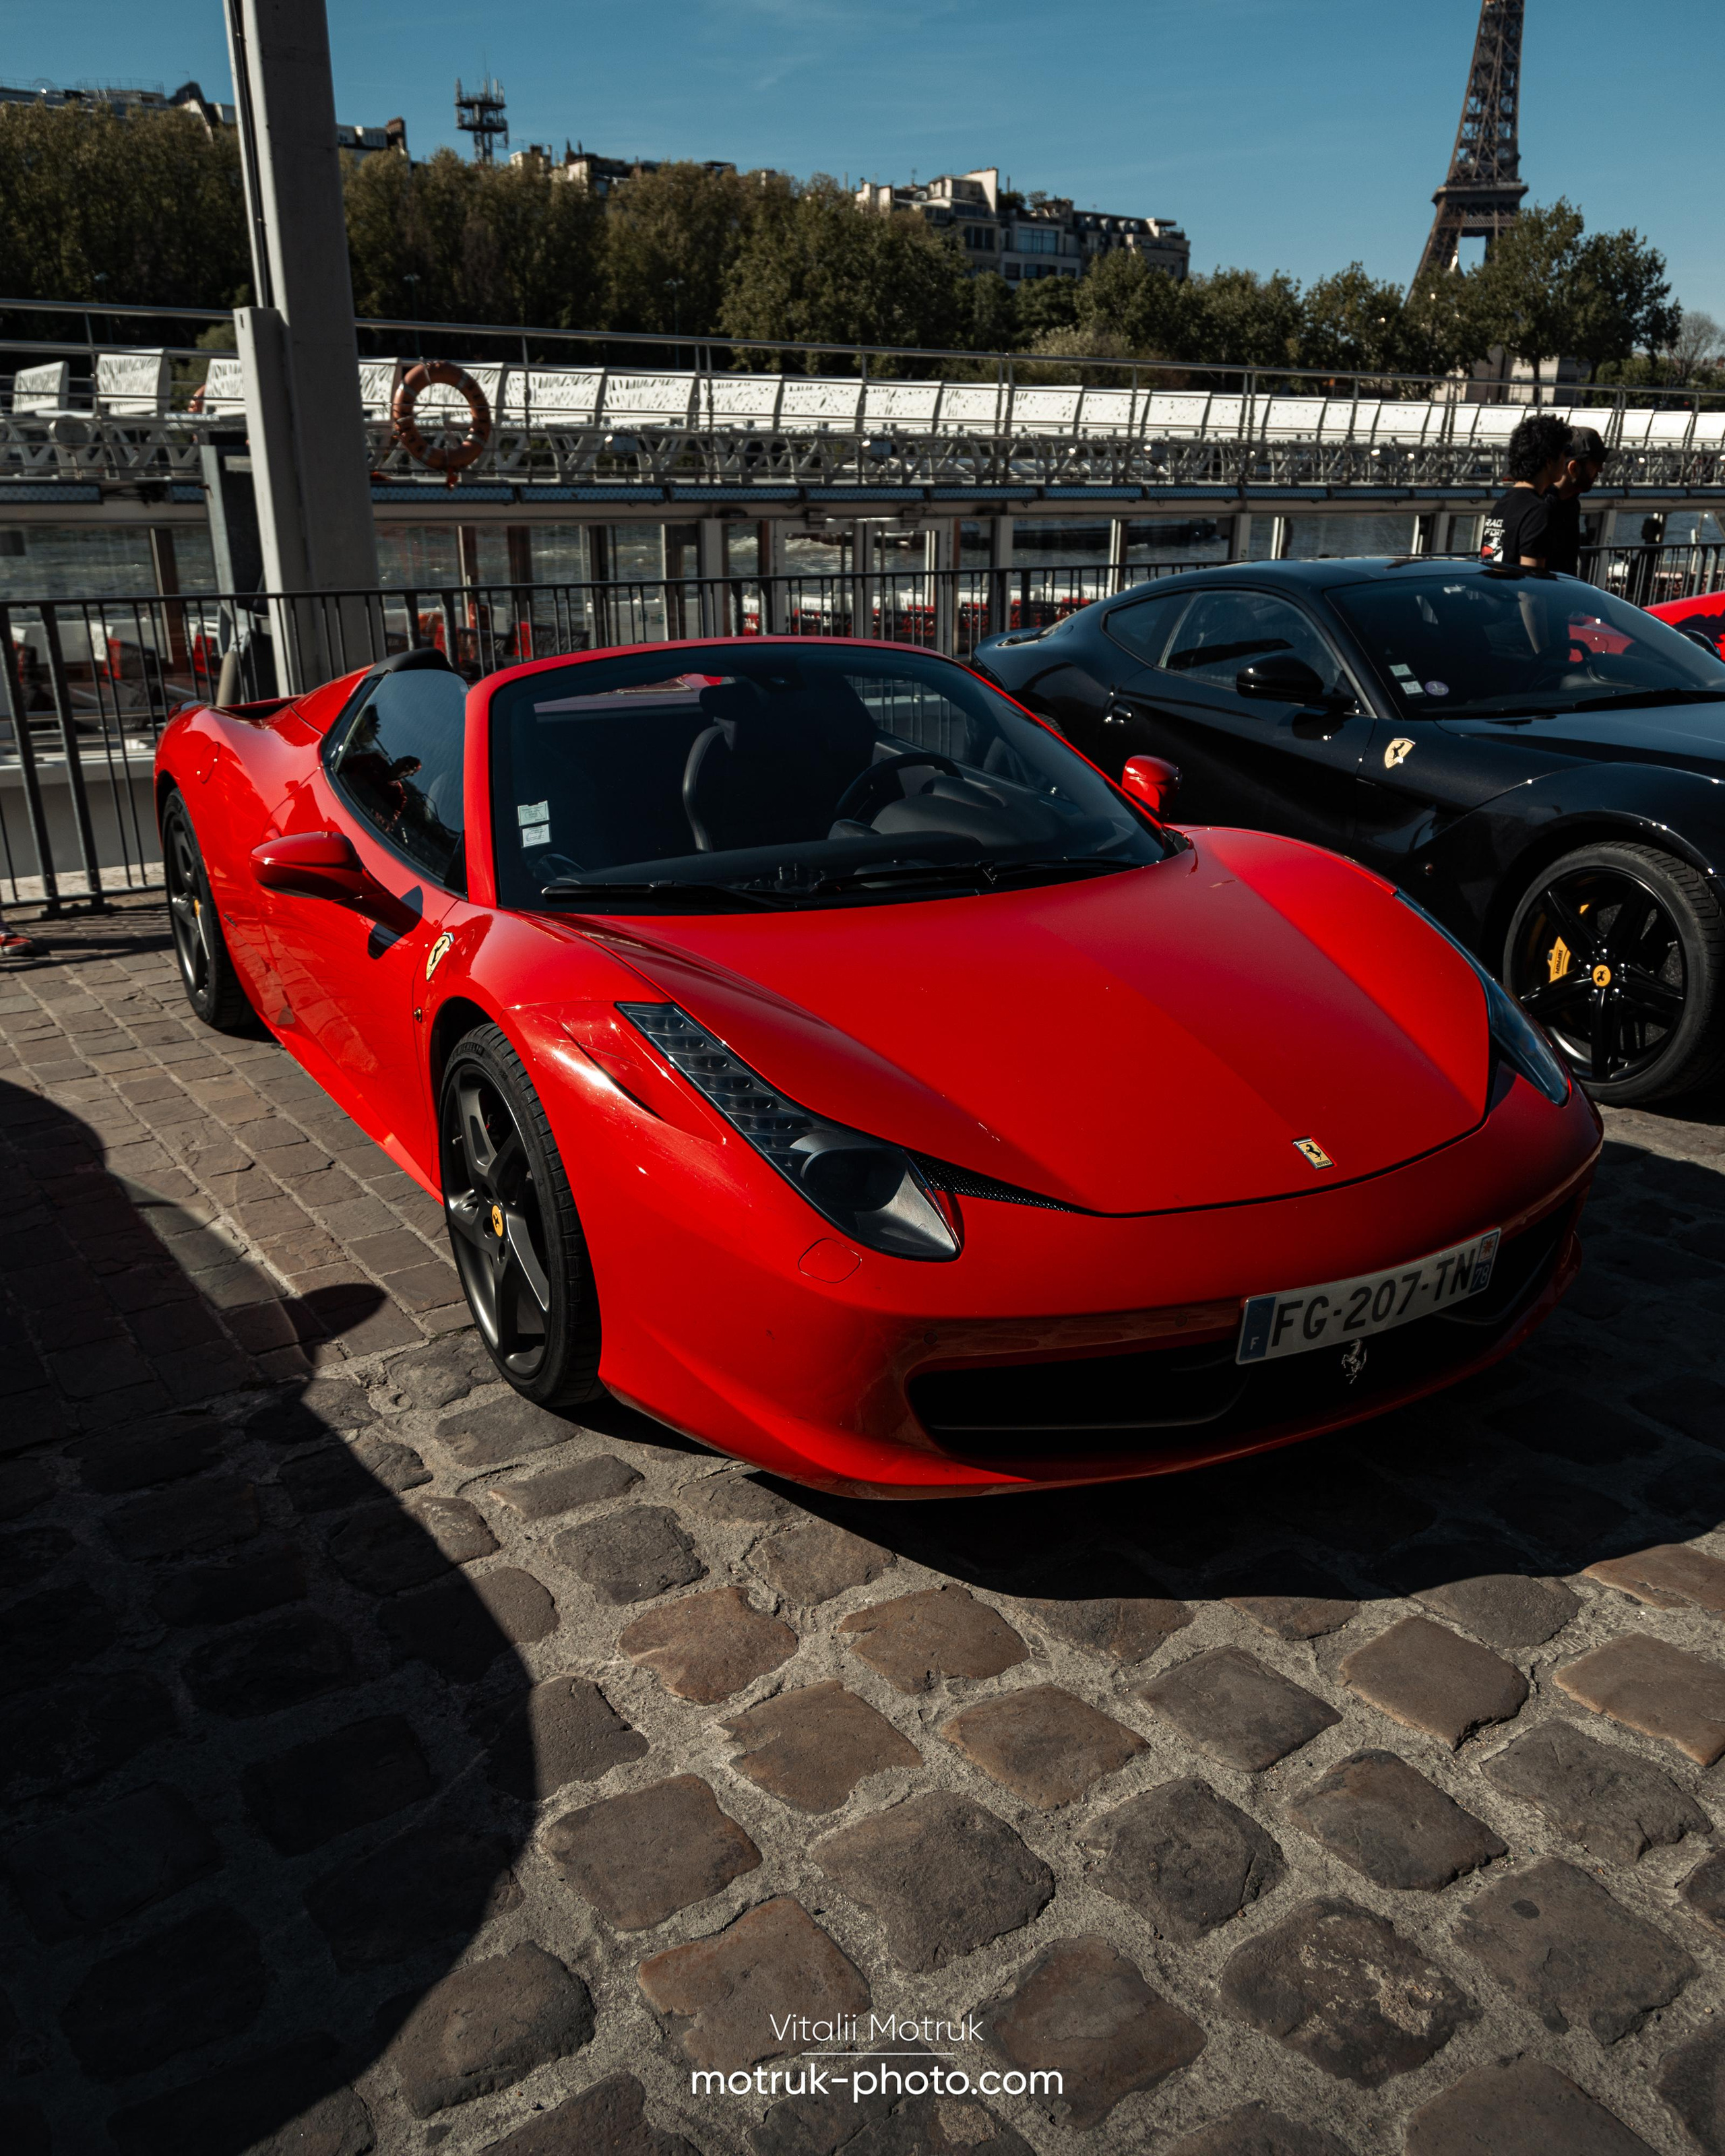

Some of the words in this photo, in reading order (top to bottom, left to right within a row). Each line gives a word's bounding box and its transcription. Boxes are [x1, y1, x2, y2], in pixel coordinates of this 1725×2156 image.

[1472, 1264, 1490, 1288] 78
[1272, 1248, 1476, 1347] FG-207-TN
[1250, 1336, 1259, 1350] F
